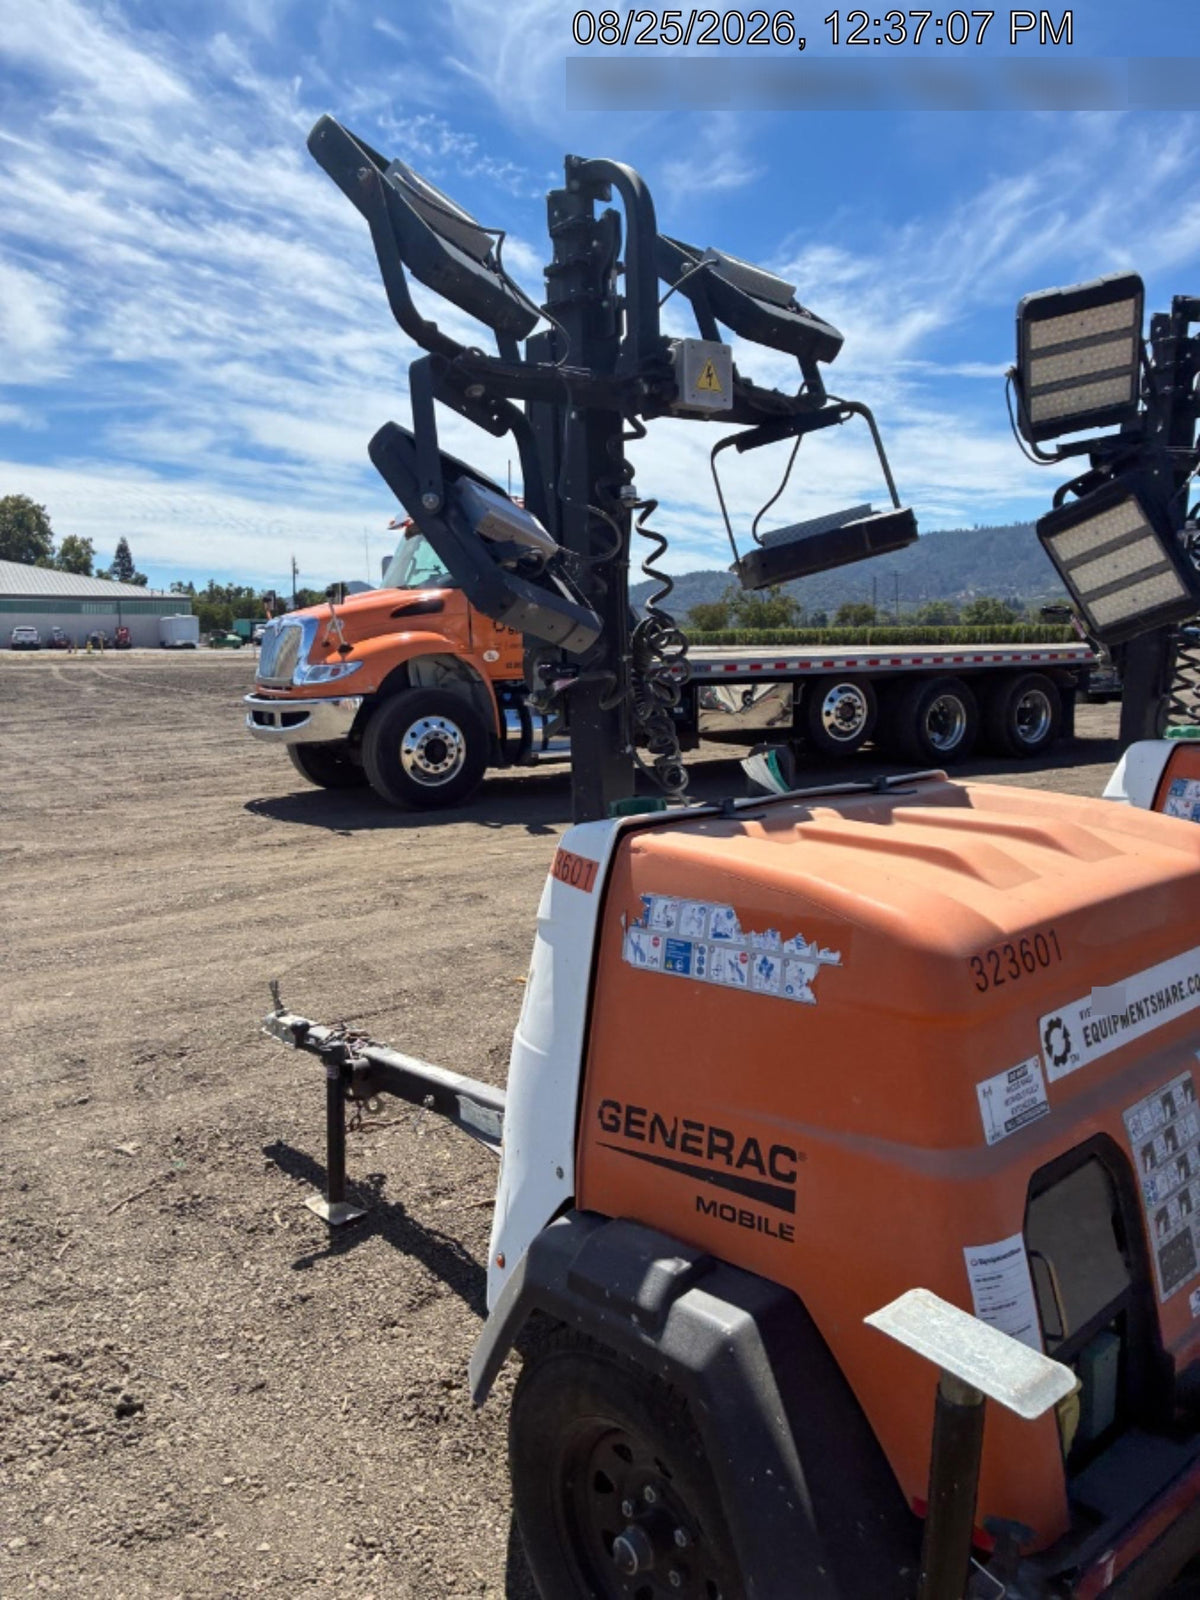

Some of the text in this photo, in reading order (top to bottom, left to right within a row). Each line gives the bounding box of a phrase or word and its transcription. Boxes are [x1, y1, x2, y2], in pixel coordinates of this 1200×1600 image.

[970, 929, 1062, 992] 323601
[597, 1099, 797, 1184] GENERAC
[695, 1195, 796, 1243] MOBILE
